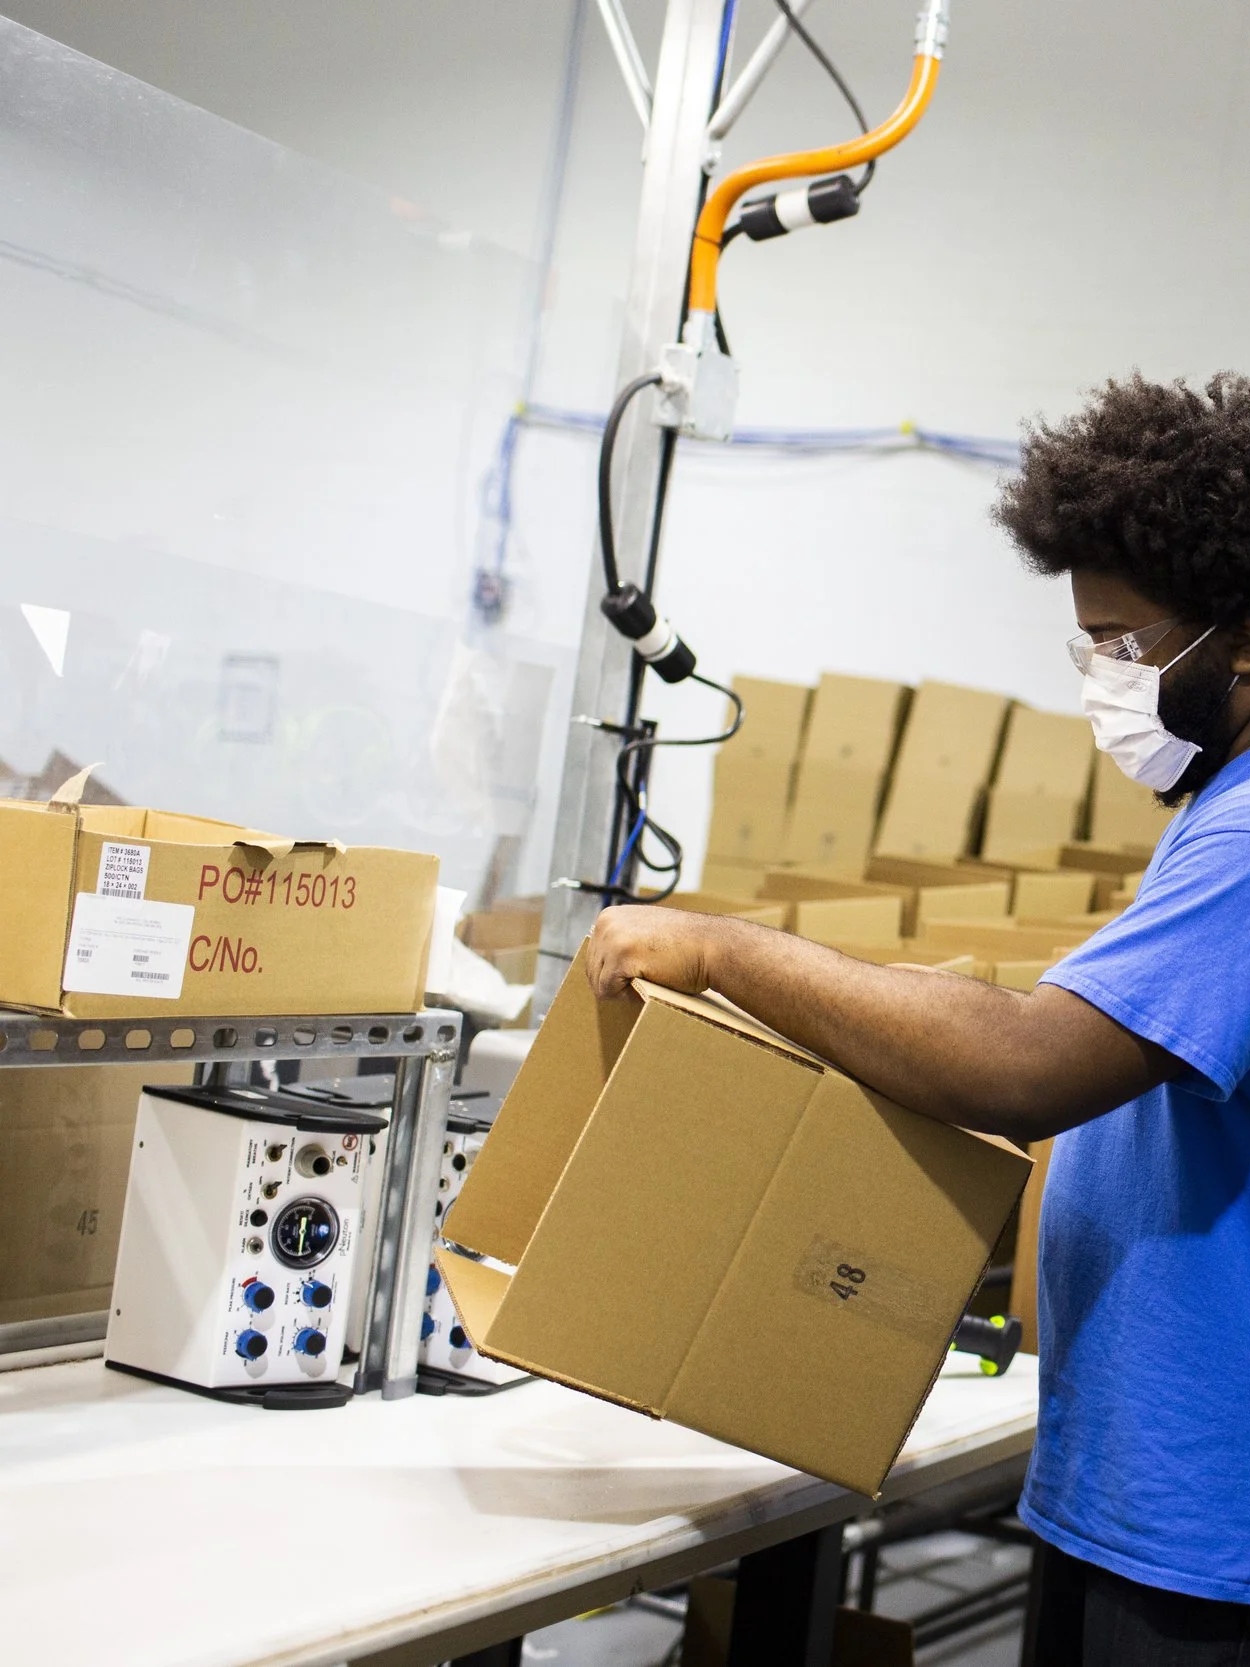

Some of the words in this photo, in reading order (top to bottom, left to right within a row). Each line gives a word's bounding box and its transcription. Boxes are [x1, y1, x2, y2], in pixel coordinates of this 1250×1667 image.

[105, 864, 128, 872] ZIPLOCK
[198, 864, 356, 909] PO#115013
[189, 935, 263, 974] C/No.
[77, 1209, 99, 1236] 45
[829, 1263, 867, 1301] 48
